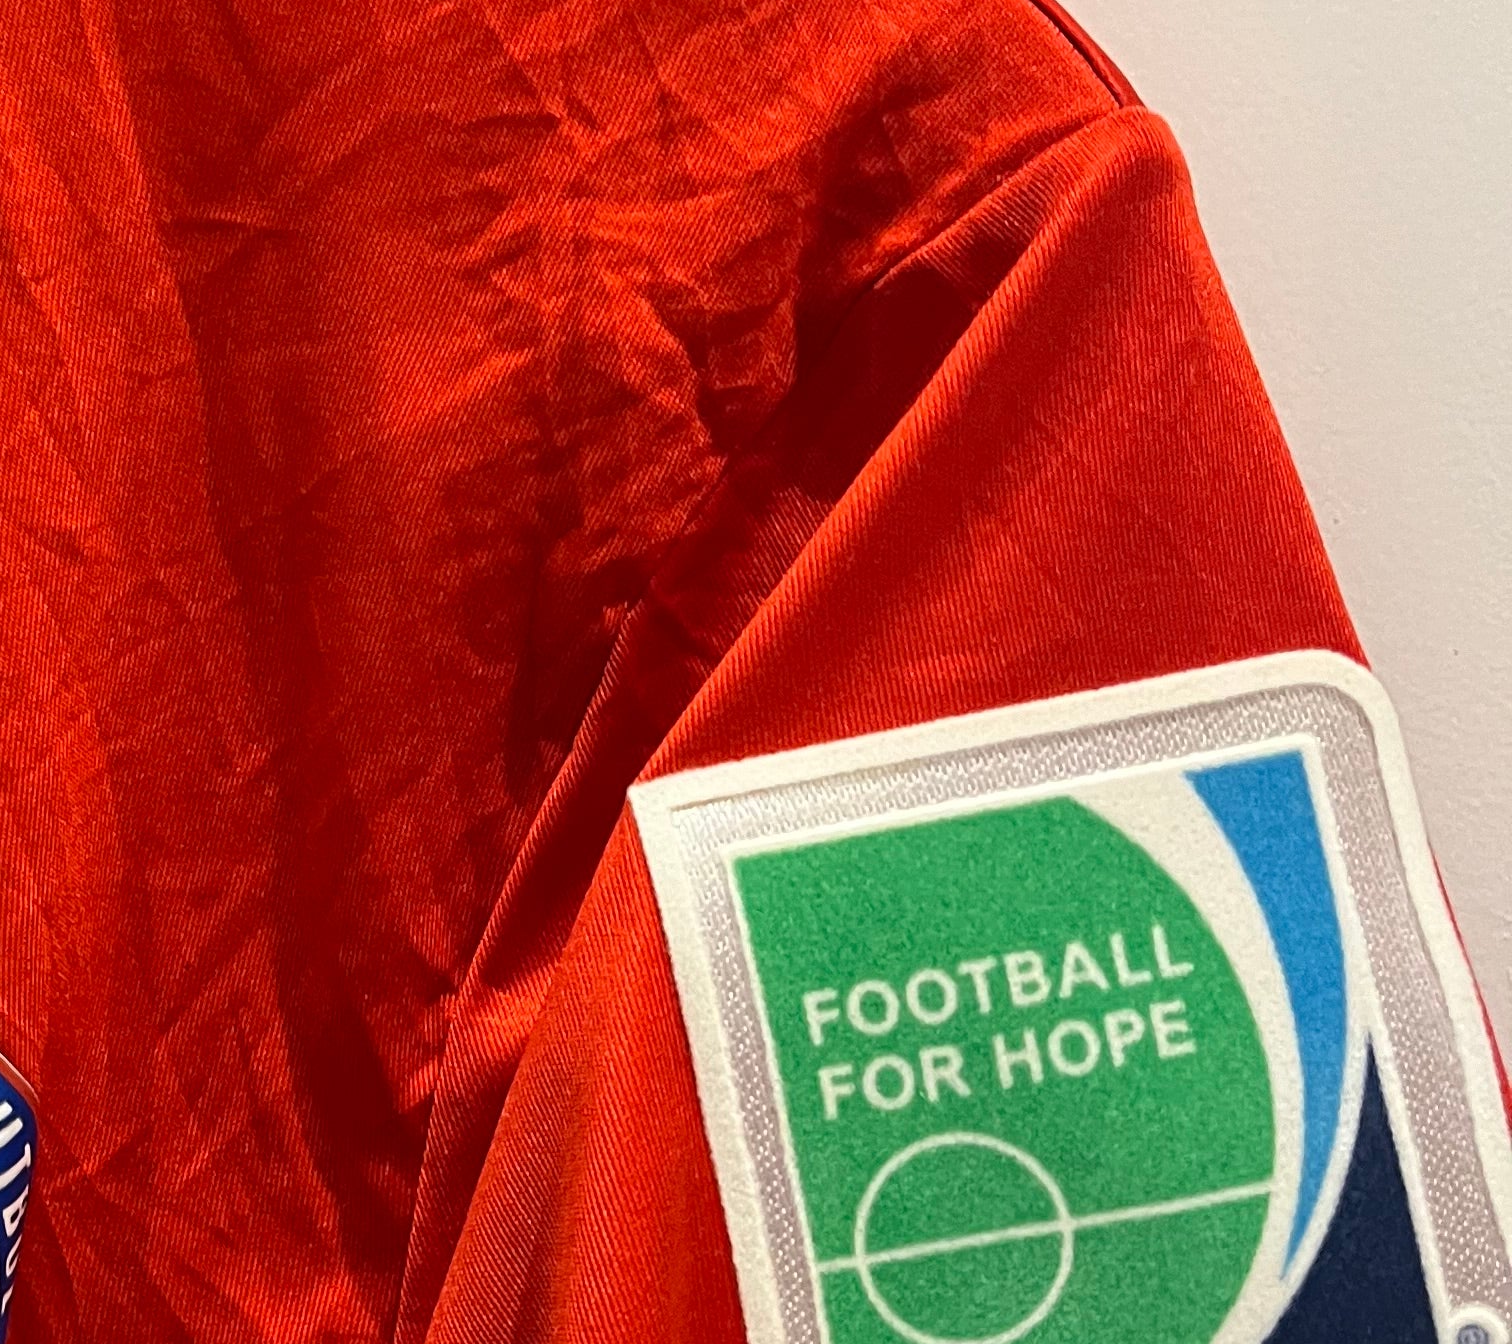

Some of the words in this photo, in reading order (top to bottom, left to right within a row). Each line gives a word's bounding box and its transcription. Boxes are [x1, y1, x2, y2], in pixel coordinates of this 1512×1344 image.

[802, 923, 1195, 1046] FOOTBALL
[817, 1047, 971, 1121] FOR
[994, 1000, 1198, 1093] HOPE
